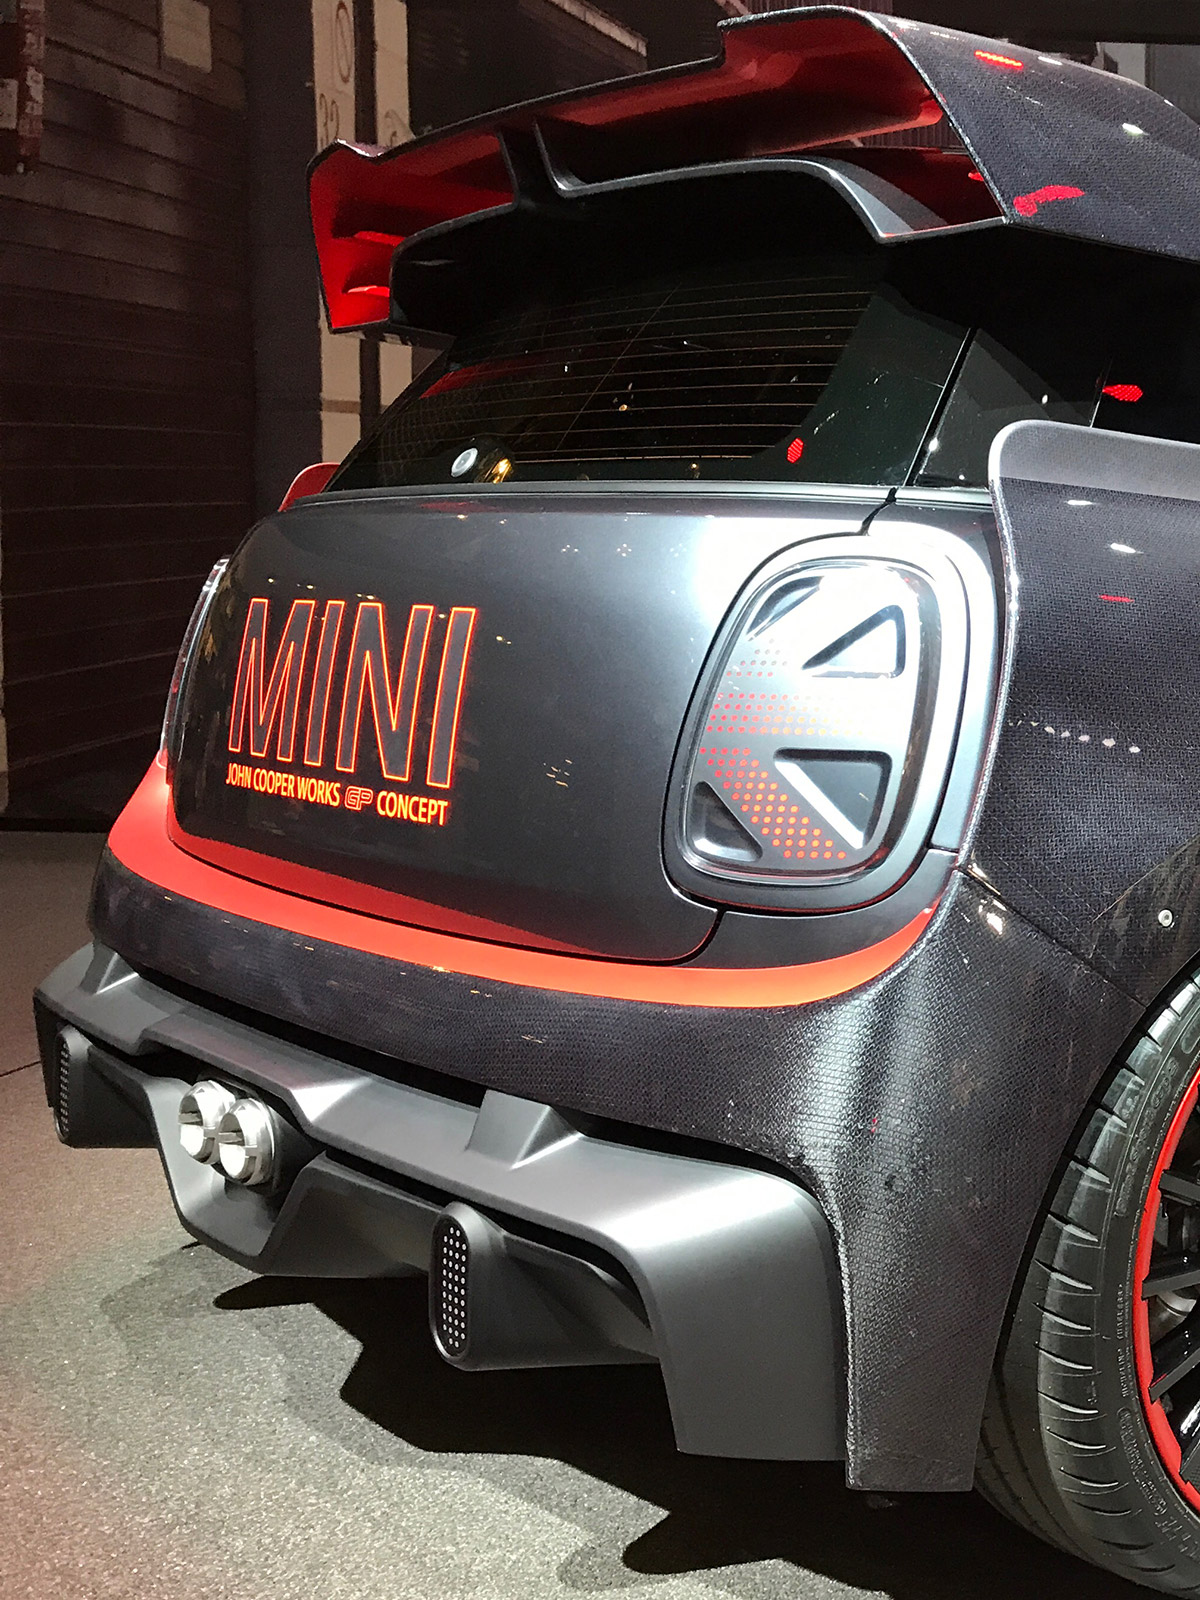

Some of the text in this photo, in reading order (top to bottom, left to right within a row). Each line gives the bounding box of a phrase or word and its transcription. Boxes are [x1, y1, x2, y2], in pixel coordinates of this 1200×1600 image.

[228, 598, 477, 789] MINI
[226, 762, 449, 826] JOHN COOPER WORKS GP CONCEPT
